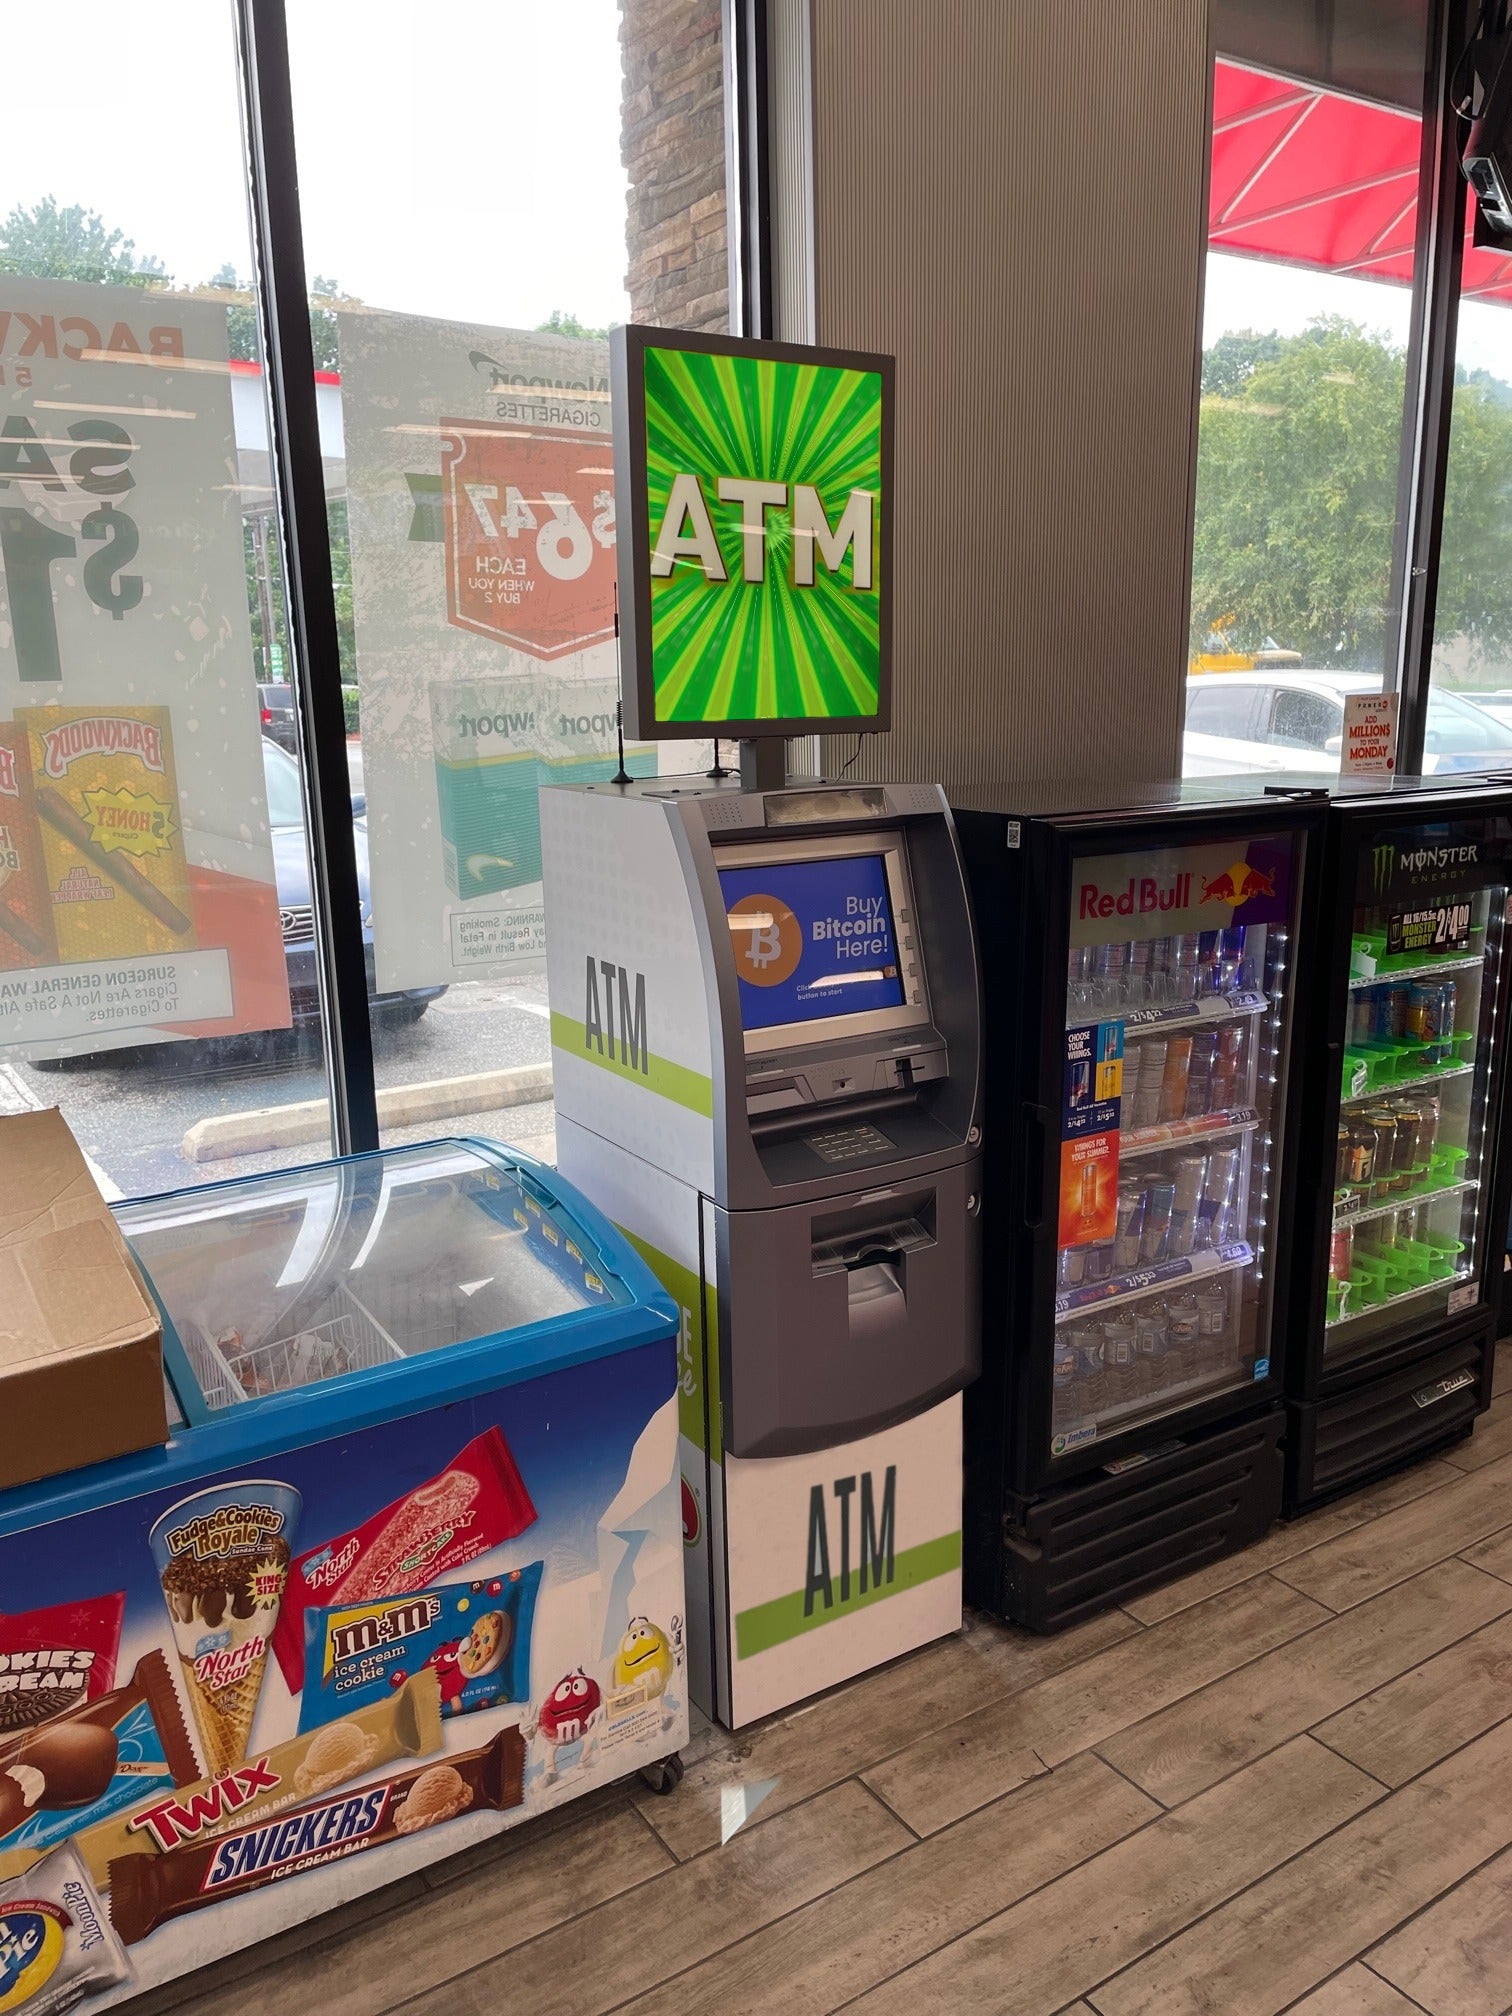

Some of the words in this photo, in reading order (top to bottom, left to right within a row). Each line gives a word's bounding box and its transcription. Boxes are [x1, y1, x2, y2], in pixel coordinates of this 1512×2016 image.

[650, 472, 873, 591] ATM
[1349, 724, 1391, 738] MILLION$
[1365, 715, 1377, 724] ADD
[1349, 745, 1388, 760] MONDAY
[1401, 845, 1478, 872] MONSTER
[1412, 870, 1466, 884] ENERGY
[846, 896, 883, 918] Buy
[1079, 878, 1135, 920] Red
[1139, 872, 1192, 913] Bull
[812, 914, 886, 941] Bitcoin
[1403, 913, 1412, 925] ALL
[1403, 920, 1437, 937] MONSTER
[836, 934, 888, 959] Here!
[1404, 933, 1433, 949] ENERGY
[797, 993, 819, 1001] button
[586, 956, 648, 1076] ATM
[1068, 1030, 1090, 1043] CHOOSE
[1068, 1041, 1084, 1052] YOUR
[1236, 1111, 1252, 1123] 3.19
[1096, 1138, 1107, 1147] FOR
[1068, 1426, 1095, 1445] Imbera
[168, 1504, 281, 1552] Fudge&Cookies
[198, 1524, 260, 1557] Royale
[257, 1545, 273, 1553] Cone
[373, 1510, 477, 1591] STRAWBERRY
[402, 1530, 452, 1571] SHORTCAKE
[803, 1465, 896, 1618] ATM
[306, 1537, 360, 1589] North
[326, 1557, 354, 1587] Star
[256, 1574, 282, 1586] KING
[257, 1584, 281, 1596] SIZE
[195, 1636, 264, 1682] North
[335, 1663, 356, 1678] ice
[360, 1646, 405, 1669] cream
[211, 1661, 251, 1690] Star
[335, 1666, 384, 1691] cookie
[557, 1719, 581, 1743] m
[113, 1776, 159, 1805] chocolate
[131, 1757, 281, 1852] Twix
[205, 1822, 227, 1838] ICE
[228, 1806, 271, 1830] CREAM
[272, 1791, 296, 1811] BAR
[210, 1788, 386, 1885] SNICKERS
[390, 1790, 408, 1801] BRAND
[271, 1861, 298, 1880] ICE
[299, 1846, 342, 1874] CREAM
[343, 1836, 370, 1857] BAR
[13, 1902, 36, 1910] Cream
[63, 1881, 105, 1942] MoonPie
